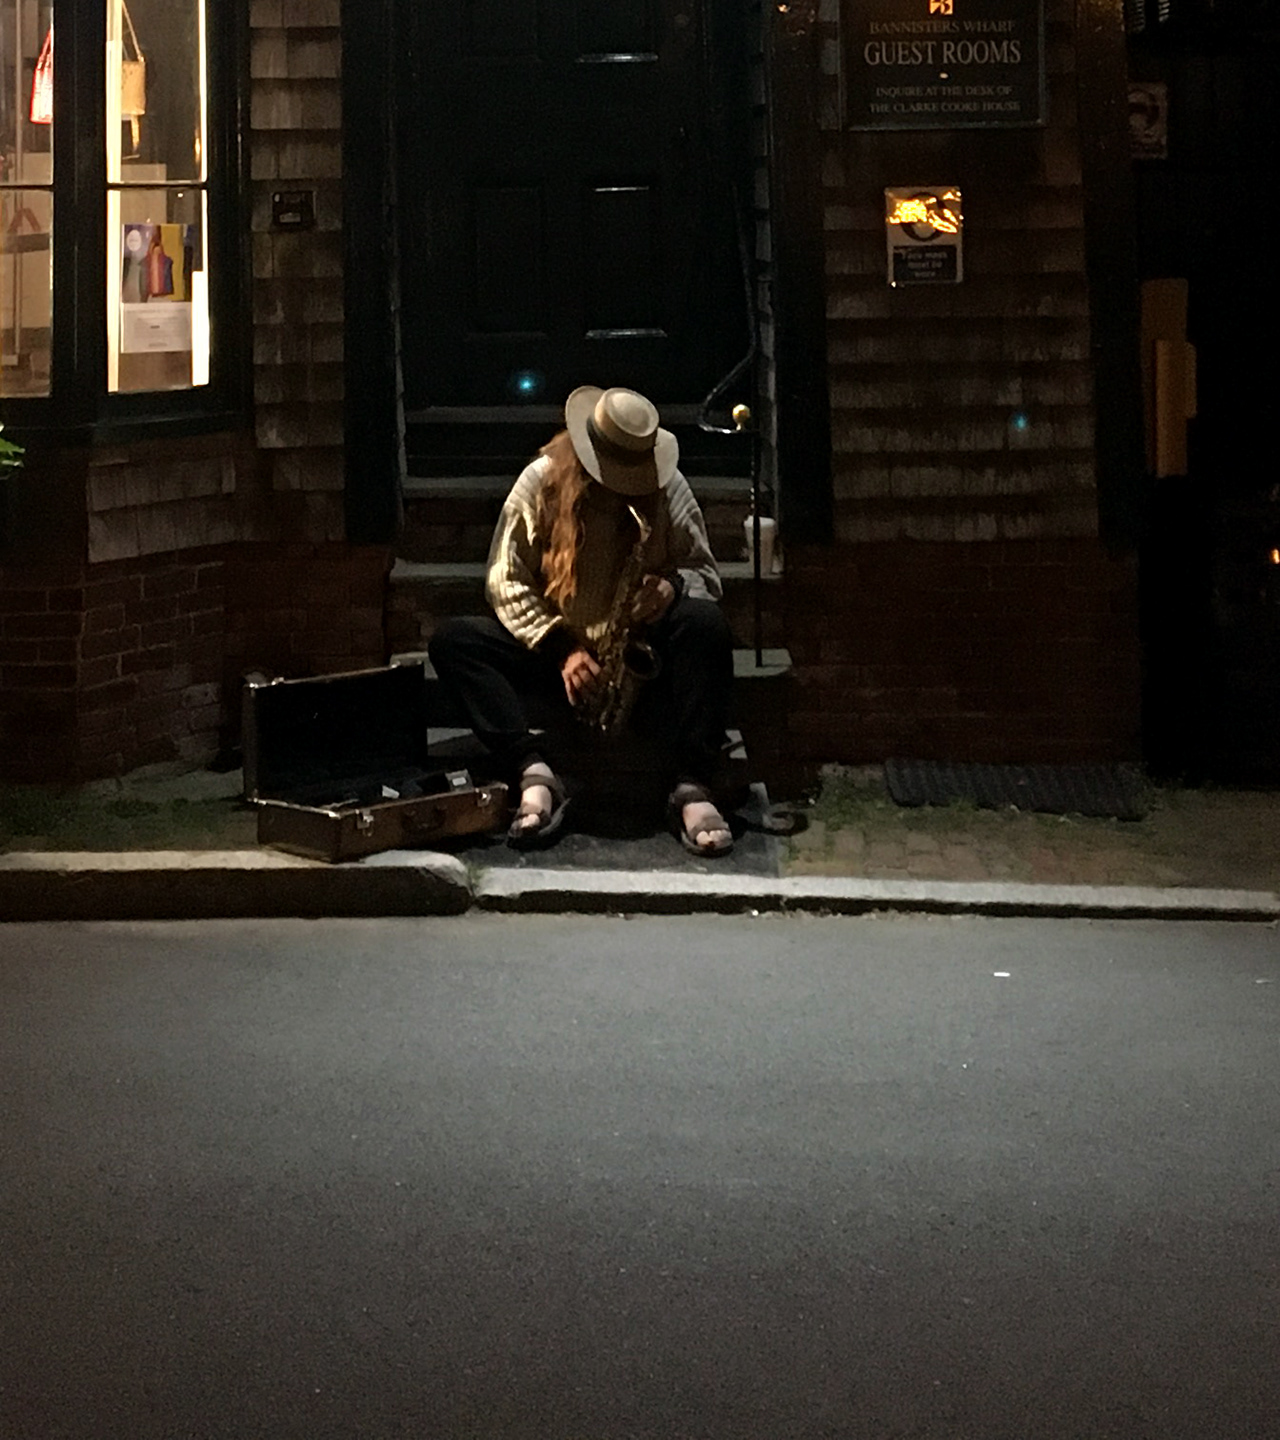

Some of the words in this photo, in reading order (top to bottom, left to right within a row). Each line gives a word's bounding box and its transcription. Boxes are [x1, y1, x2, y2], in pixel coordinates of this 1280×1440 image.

[863, 40, 937, 66] GUEST
[942, 39, 1022, 65] ROOMS
[941, 86, 964, 96] THE
[869, 102, 889, 113] THE
